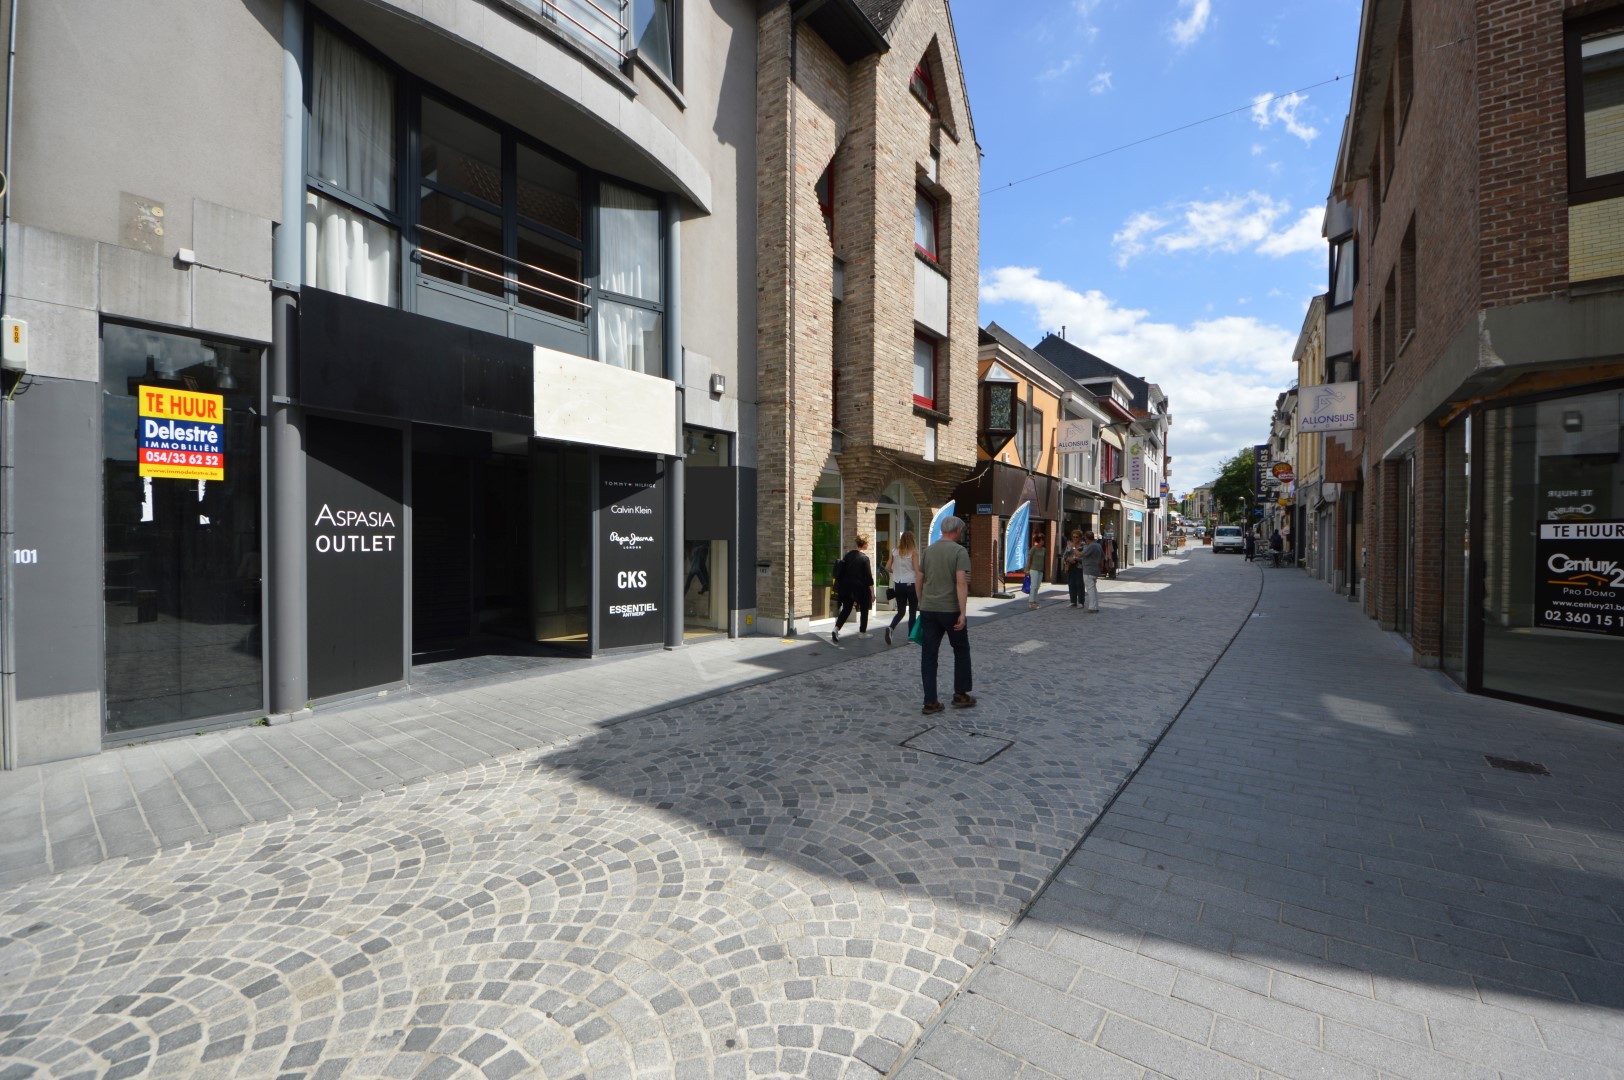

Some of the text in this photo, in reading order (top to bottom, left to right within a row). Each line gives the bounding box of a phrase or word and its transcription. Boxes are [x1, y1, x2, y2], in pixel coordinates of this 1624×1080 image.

[146, 392, 217, 419] TE HUUR
[1302, 413, 1355, 425] ALLONSIUS
[145, 419, 218, 443] Delestré
[145, 441, 219, 453] IMMOBILIËN
[1058, 440, 1089, 448] ALLONSIUS
[146, 451, 219, 466] 054/33 62 52
[611, 504, 652, 515] Calvin Klein
[609, 531, 654, 545] Pepe Jeans
[1553, 524, 1624, 537] TE HUUR
[315, 535, 396, 552] OUTLET
[14, 549, 37, 564] 101
[1547, 553, 1618, 575] Century
[617, 570, 647, 589] CKS
[609, 602, 658, 615] ESSENTIEL
[1545, 609, 1561, 621] 02
[1565, 611, 1591, 624] 360
[1596, 614, 1613, 626] 15
